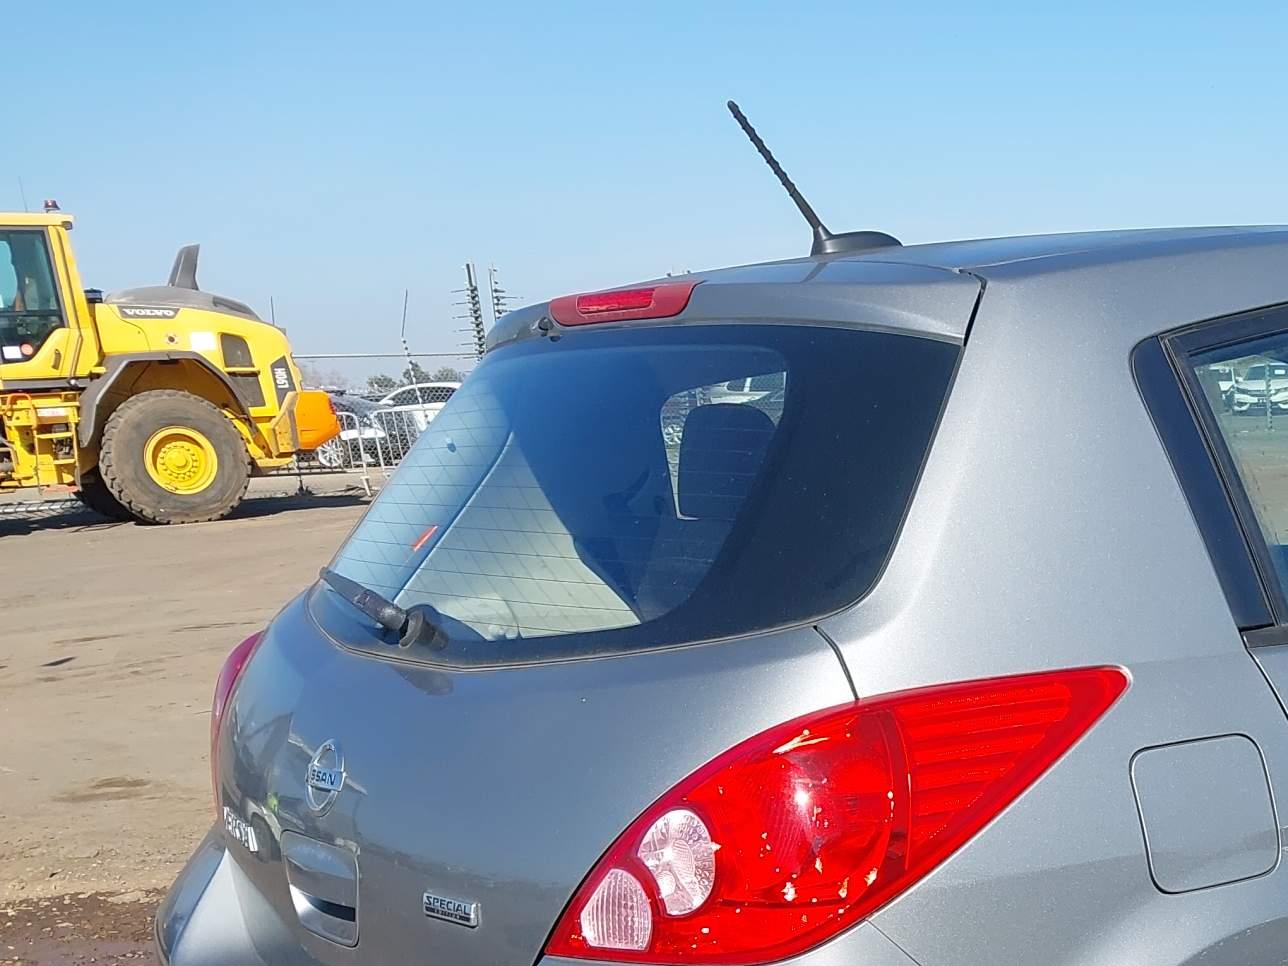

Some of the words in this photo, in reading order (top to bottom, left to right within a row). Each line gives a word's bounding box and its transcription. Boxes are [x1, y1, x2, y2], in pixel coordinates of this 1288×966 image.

[122, 308, 176, 317] VOLVO
[273, 367, 290, 389] L90H
[307, 768, 337, 786] SSAN
[424, 895, 472, 916] SPECIAL
